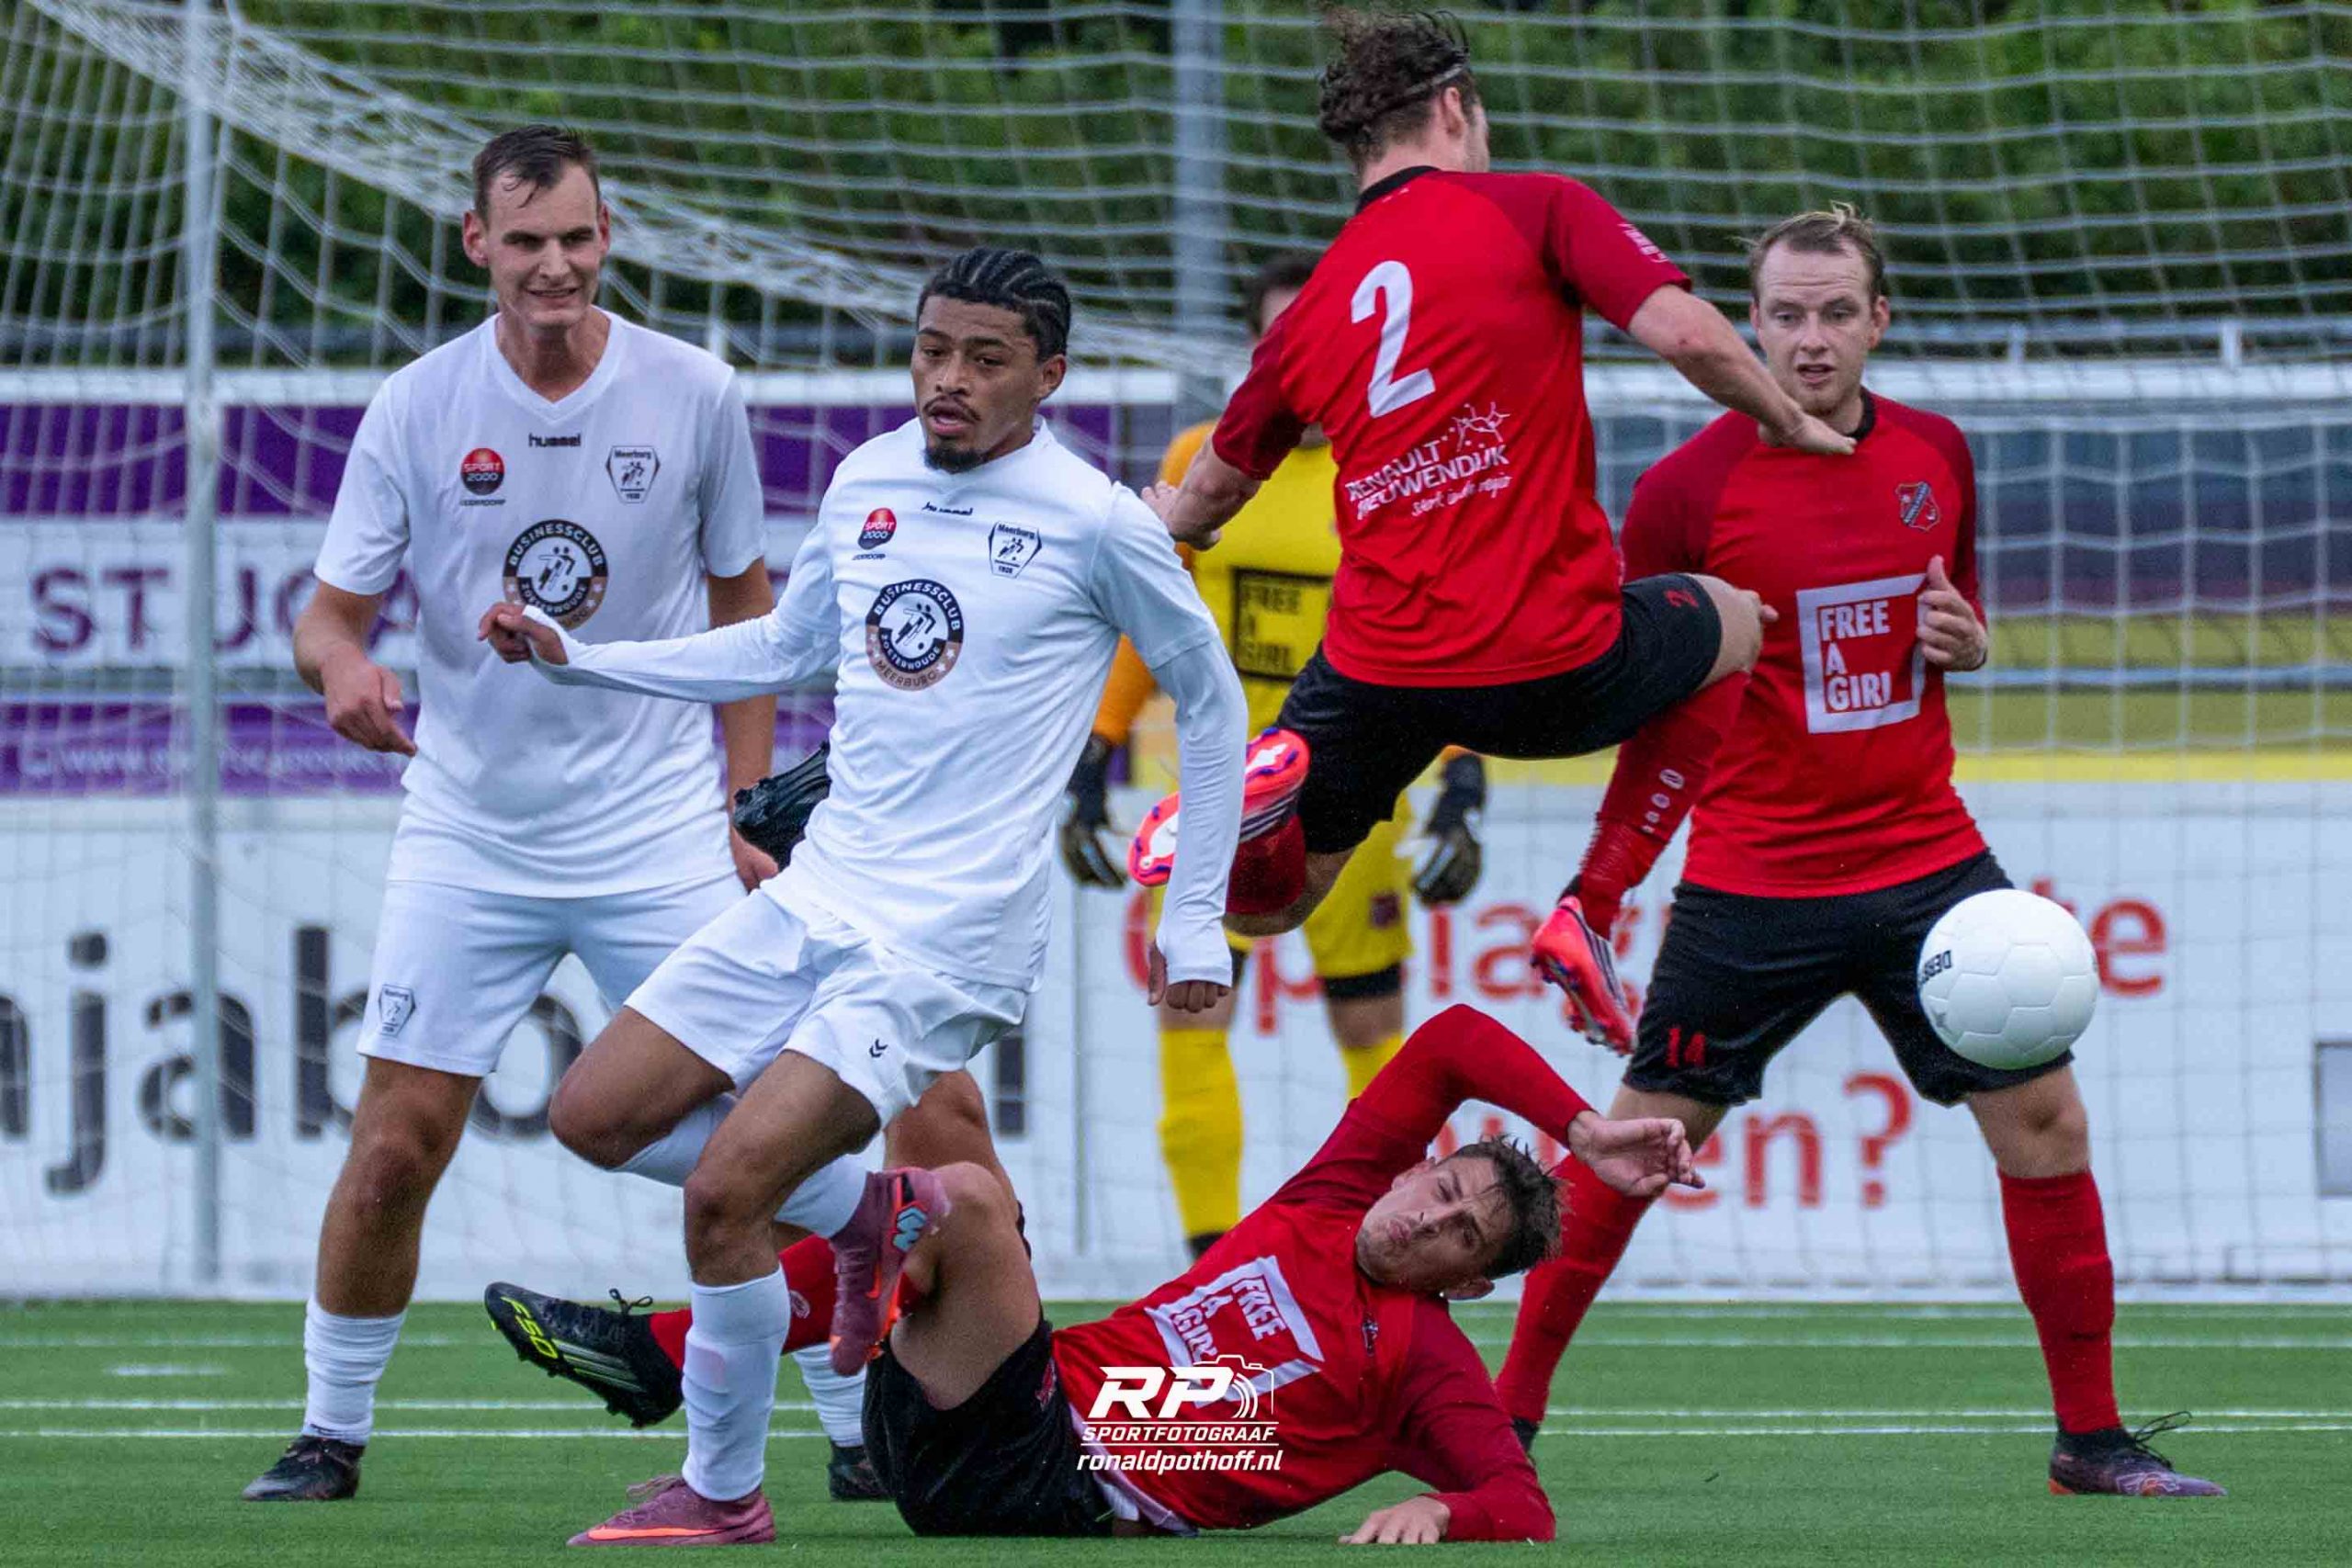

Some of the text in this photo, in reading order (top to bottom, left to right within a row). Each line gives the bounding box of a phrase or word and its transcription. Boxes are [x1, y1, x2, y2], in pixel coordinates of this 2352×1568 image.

[1351, 260, 1436, 418] 2
[463, 462, 501, 472] SPORT
[466, 472, 498, 482] 2000
[1345, 440, 1441, 502] RENAULT
[509, 523, 605, 567] BUSINESSCLUB
[863, 530, 888, 539] 2000
[865, 521, 894, 531] SPORT
[998, 523, 1035, 541] Meerburg
[32, 566, 170, 651] ST
[873, 582, 961, 631] BUSINESSCLUB
[1819, 600, 1891, 642] FREE
[876, 660, 937, 687] MEERBURG
[1826, 641, 1849, 676] A
[1665, 1025, 1706, 1068] 14
[1202, 1293, 1233, 1320] A
[1230, 1277, 1286, 1342] FREE
